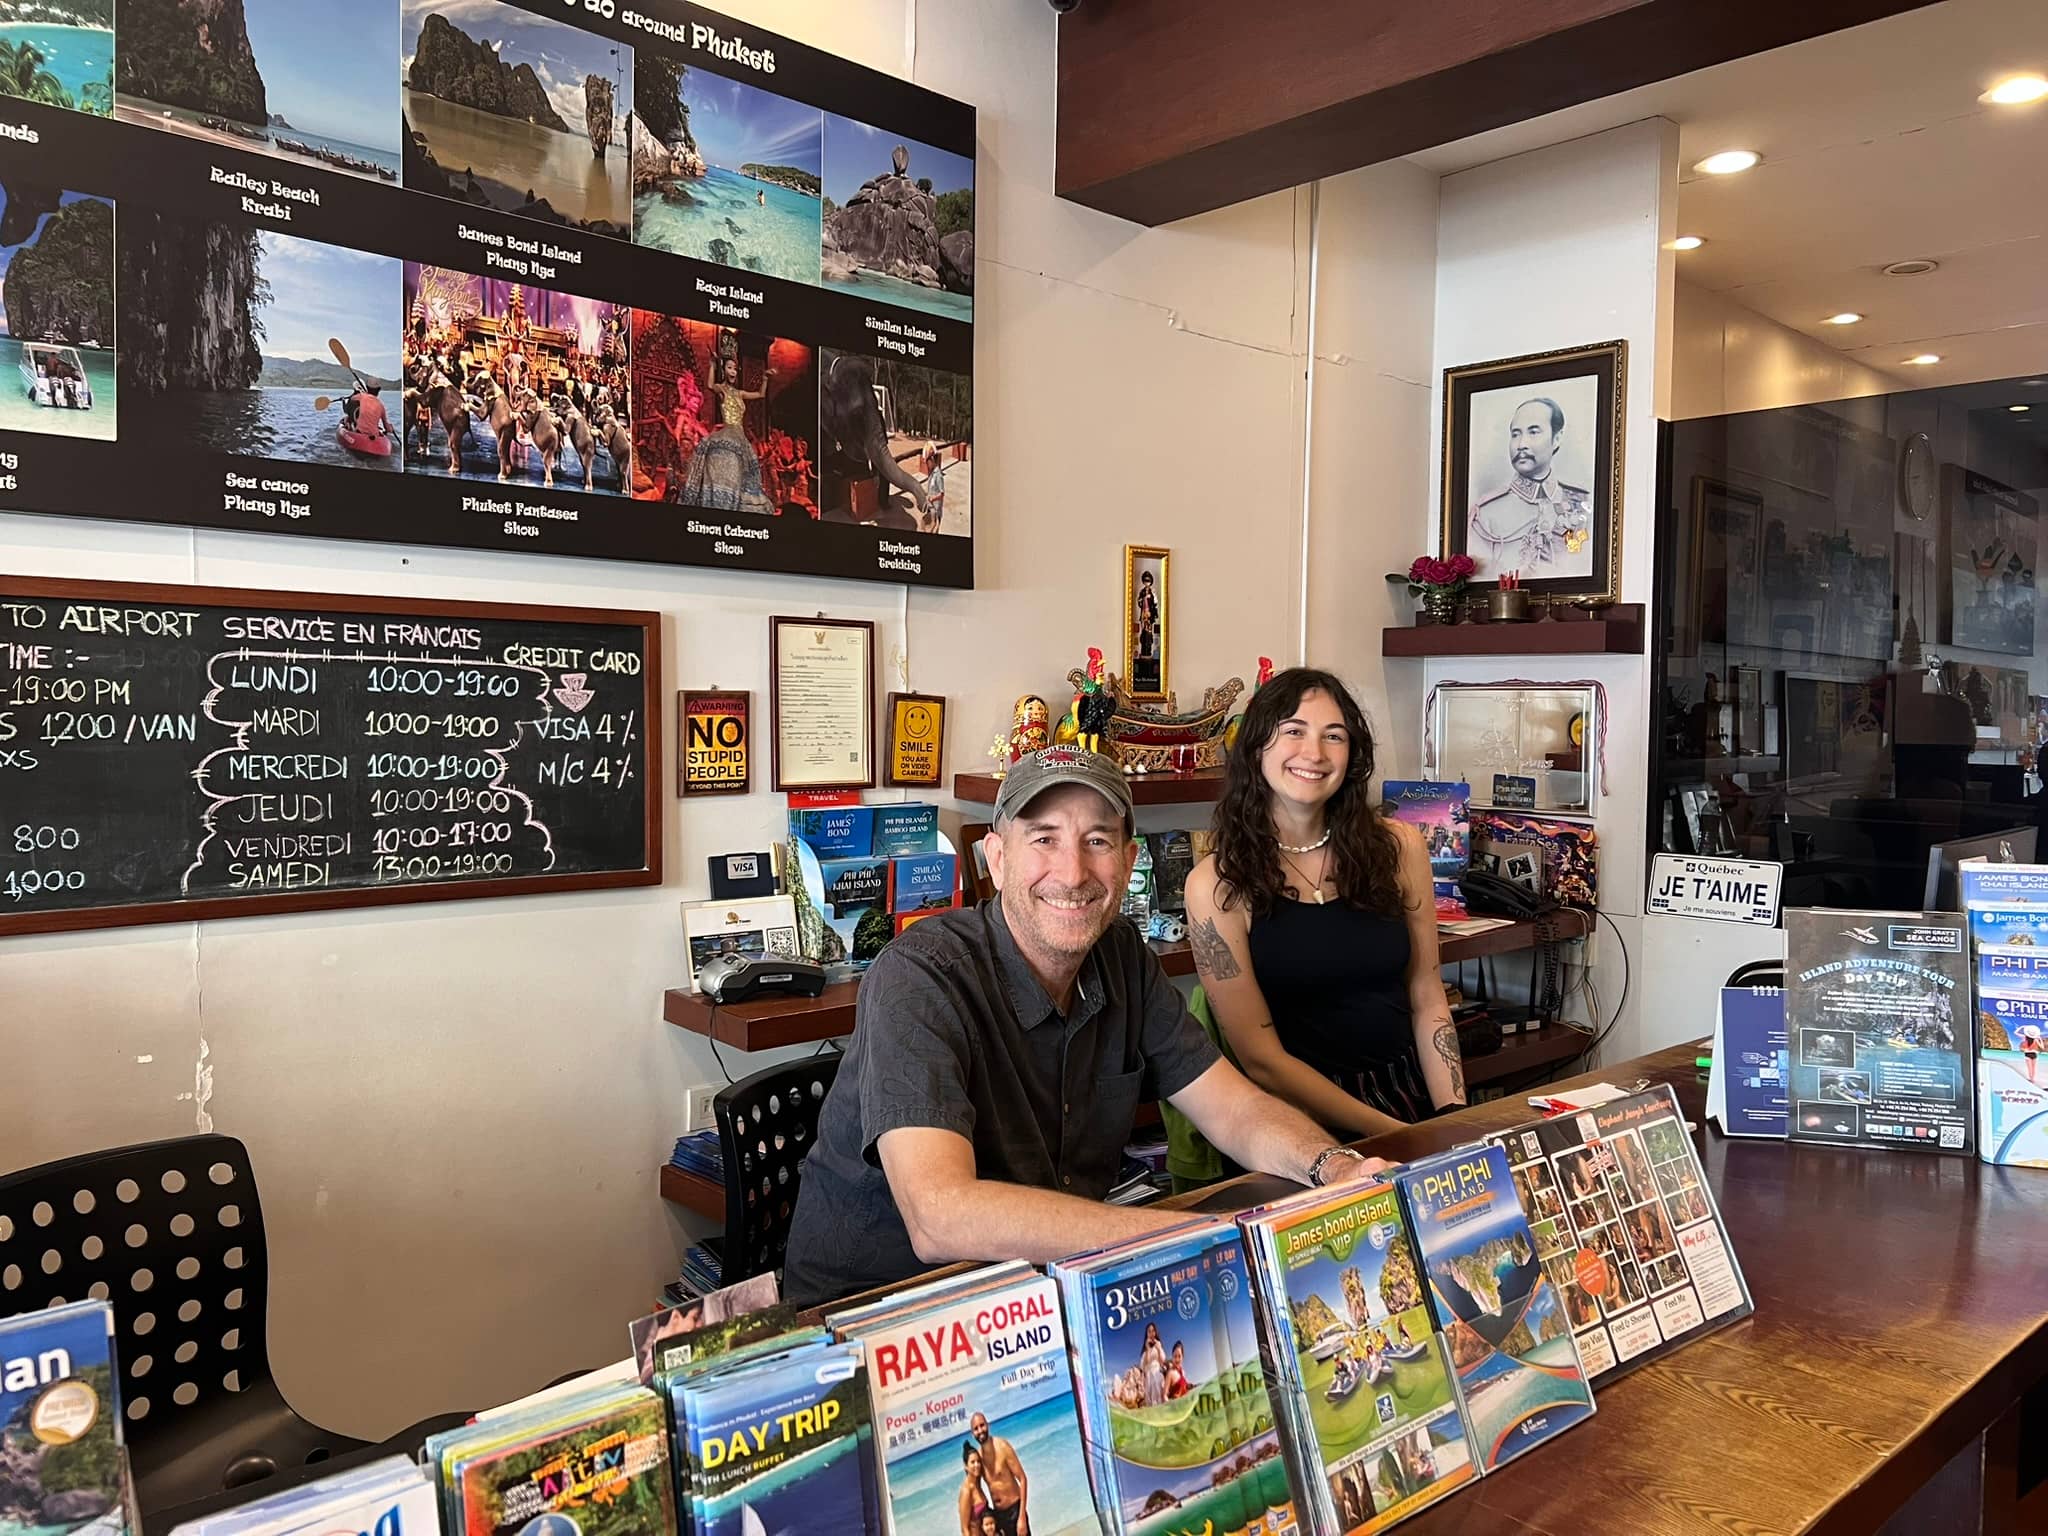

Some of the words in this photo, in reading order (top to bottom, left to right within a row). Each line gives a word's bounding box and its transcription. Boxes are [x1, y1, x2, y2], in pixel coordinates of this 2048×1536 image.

[621, 11, 685, 42] around
[691, 22, 776, 74] Phuket
[210, 166, 268, 196] Railey
[271, 180, 321, 207] Beach
[241, 196, 293, 221] Krabi
[458, 224, 504, 248] James
[506, 235, 539, 254] Bond
[541, 244, 582, 265] Island
[487, 251, 529, 276] Phang
[531, 262, 556, 279] Nga
[695, 278, 727, 299] Raya
[729, 286, 764, 304] Island
[709, 300, 750, 320] Phuket
[865, 316, 902, 336] Similan
[903, 325, 937, 343] Islands
[877, 336, 906, 354] Phang
[907, 343, 926, 357] Nga
[225, 472, 258, 489] Sea
[261, 478, 310, 496] canoe
[224, 494, 276, 517] Phang
[279, 499, 312, 519] Nga
[462, 496, 512, 515] Phuket
[515, 502, 579, 521] Fantasea
[503, 521, 540, 537] Show
[687, 520, 722, 537] Simon
[724, 524, 770, 540] Cabaret
[714, 541, 743, 556] Show
[879, 540, 921, 556] Elephant
[878, 557, 921, 574] Trekking
[1, 604, 46, 629] TO
[59, 605, 200, 638] AIRPORT
[223, 616, 335, 642] SERVICE
[343, 624, 375, 645] EN
[384, 624, 482, 650] FRANCAIS
[503, 642, 583, 668] CREDIT
[590, 651, 641, 674] CARD
[95, 678, 131, 705] PM
[231, 666, 317, 694] LUNDI
[701, 702, 744, 711] WARNING
[253, 707, 320, 737] MARDI
[536, 716, 591, 742] VISA
[688, 717, 744, 748] NO
[688, 751, 744, 763] STUPID
[900, 741, 933, 752] SMILE
[229, 754, 348, 781] MERCREDI
[367, 752, 500, 781] 10:00-19:00
[538, 753, 584, 787] M/C
[687, 766, 745, 778] PEOPLE
[237, 792, 332, 823] JEUDI
[370, 788, 511, 817] 10:00-19:00
[827, 818, 851, 829] JAMES
[827, 828, 850, 837] BOND
[884, 826, 908, 834] BAMBOO
[909, 825, 929, 833] ISLAND
[895, 817, 904, 825] PHI
[905, 816, 927, 825] ISLANDS
[13, 824, 80, 853] 800
[224, 832, 350, 859] VENDREDI
[372, 821, 512, 855] 10:00-17:00
[1505, 833, 1558, 850] FantaSea
[228, 862, 330, 889] SAMEDI
[372, 852, 512, 881] 13:00-19:00
[733, 862, 754, 872] VISA
[844, 870, 858, 880] PHI
[859, 869, 872, 879] PHI
[912, 864, 942, 876] SIMILAN
[912, 873, 942, 884] ISLANDS
[1697, 863, 1744, 876] Québec
[1975, 874, 2018, 882] JAMES
[854, 879, 881, 889] ISLAND
[1659, 876, 1686, 897] JE
[1693, 878, 1768, 906] T'AIME
[1705, 908, 1736, 917] souviens
[1996, 913, 2027, 923] James
[1925, 936, 1956, 944] CANOE
[1799, 960, 1842, 983] ISLAND
[1844, 958, 1920, 974] ADVENTURE
[1921, 968, 1956, 989] TOUR
[1991, 956, 2027, 969] PHI
[1844, 973, 1873, 984] Day
[1875, 971, 1907, 987] Trip
[2010, 1001, 2035, 1014] Phi
[1423, 1170, 1456, 1201] PHI
[1457, 1157, 1492, 1188] PHI
[1438, 1182, 1485, 1208] ISLAND
[1287, 1226, 1324, 1254] James
[1324, 1209, 1354, 1235] bond
[1356, 1196, 1392, 1224] Island
[1332, 1234, 1350, 1252] VIP
[976, 1293, 1054, 1336] CORAL
[1105, 1288, 1128, 1330] 3
[1127, 1275, 1171, 1306] KHAI
[1128, 1300, 1173, 1323] ISLAND
[875, 1321, 974, 1389] RAYA
[987, 1325, 1052, 1361] ISLAND
[0, 1347, 71, 1394] an
[1001, 1369, 1017, 1386] Full
[1020, 1367, 1034, 1380] Day
[1038, 1359, 1055, 1373] Trip
[925, 1393, 964, 1415] Корал
[701, 1422, 770, 1469] DAY
[776, 1399, 841, 1443] TRIP
[721, 1464, 752, 1481] LUNCH
[752, 1452, 785, 1470] BUFFET
